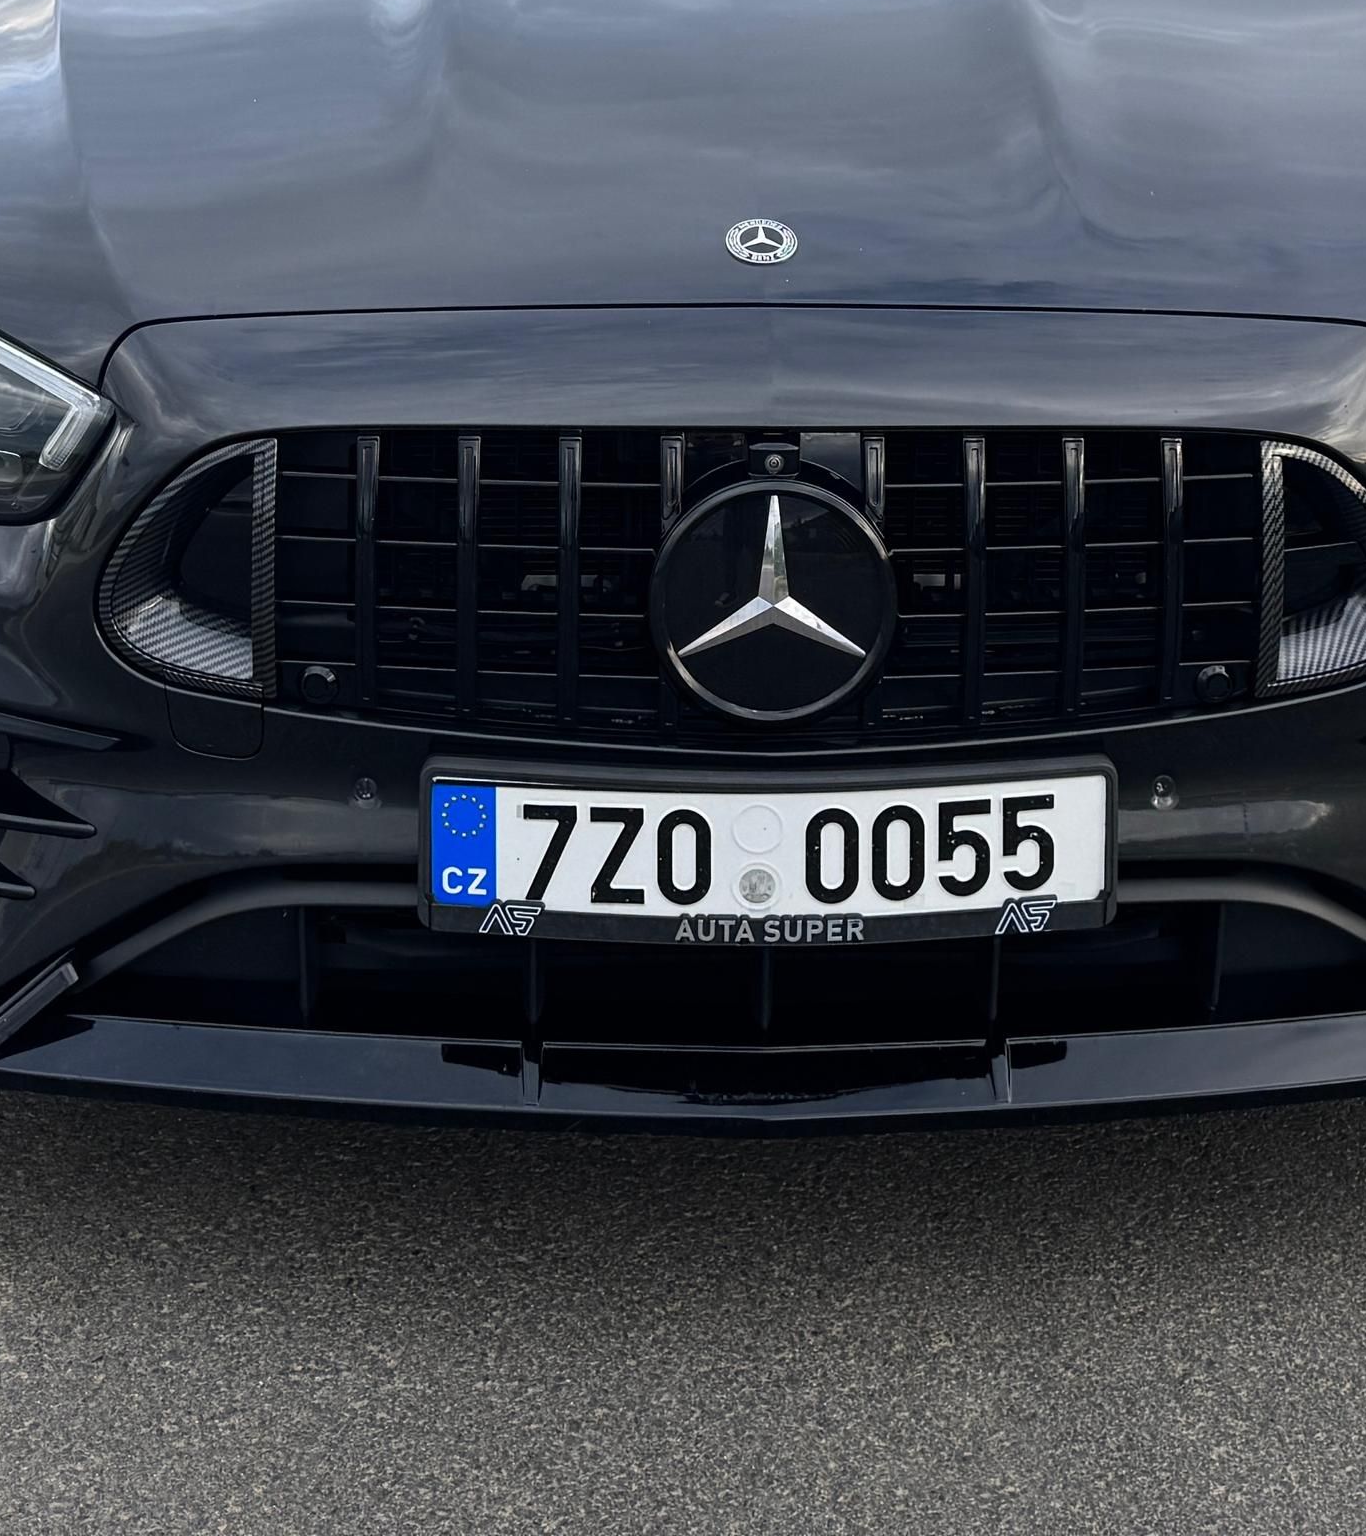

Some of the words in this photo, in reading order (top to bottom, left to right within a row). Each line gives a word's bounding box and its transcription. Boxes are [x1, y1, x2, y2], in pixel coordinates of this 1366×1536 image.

[522, 803, 712, 906] 7Z0
[805, 793, 1055, 905] 0055
[441, 867, 487, 895] CZ
[675, 919, 755, 943] AUTA
[763, 918, 865, 943] SUPER
